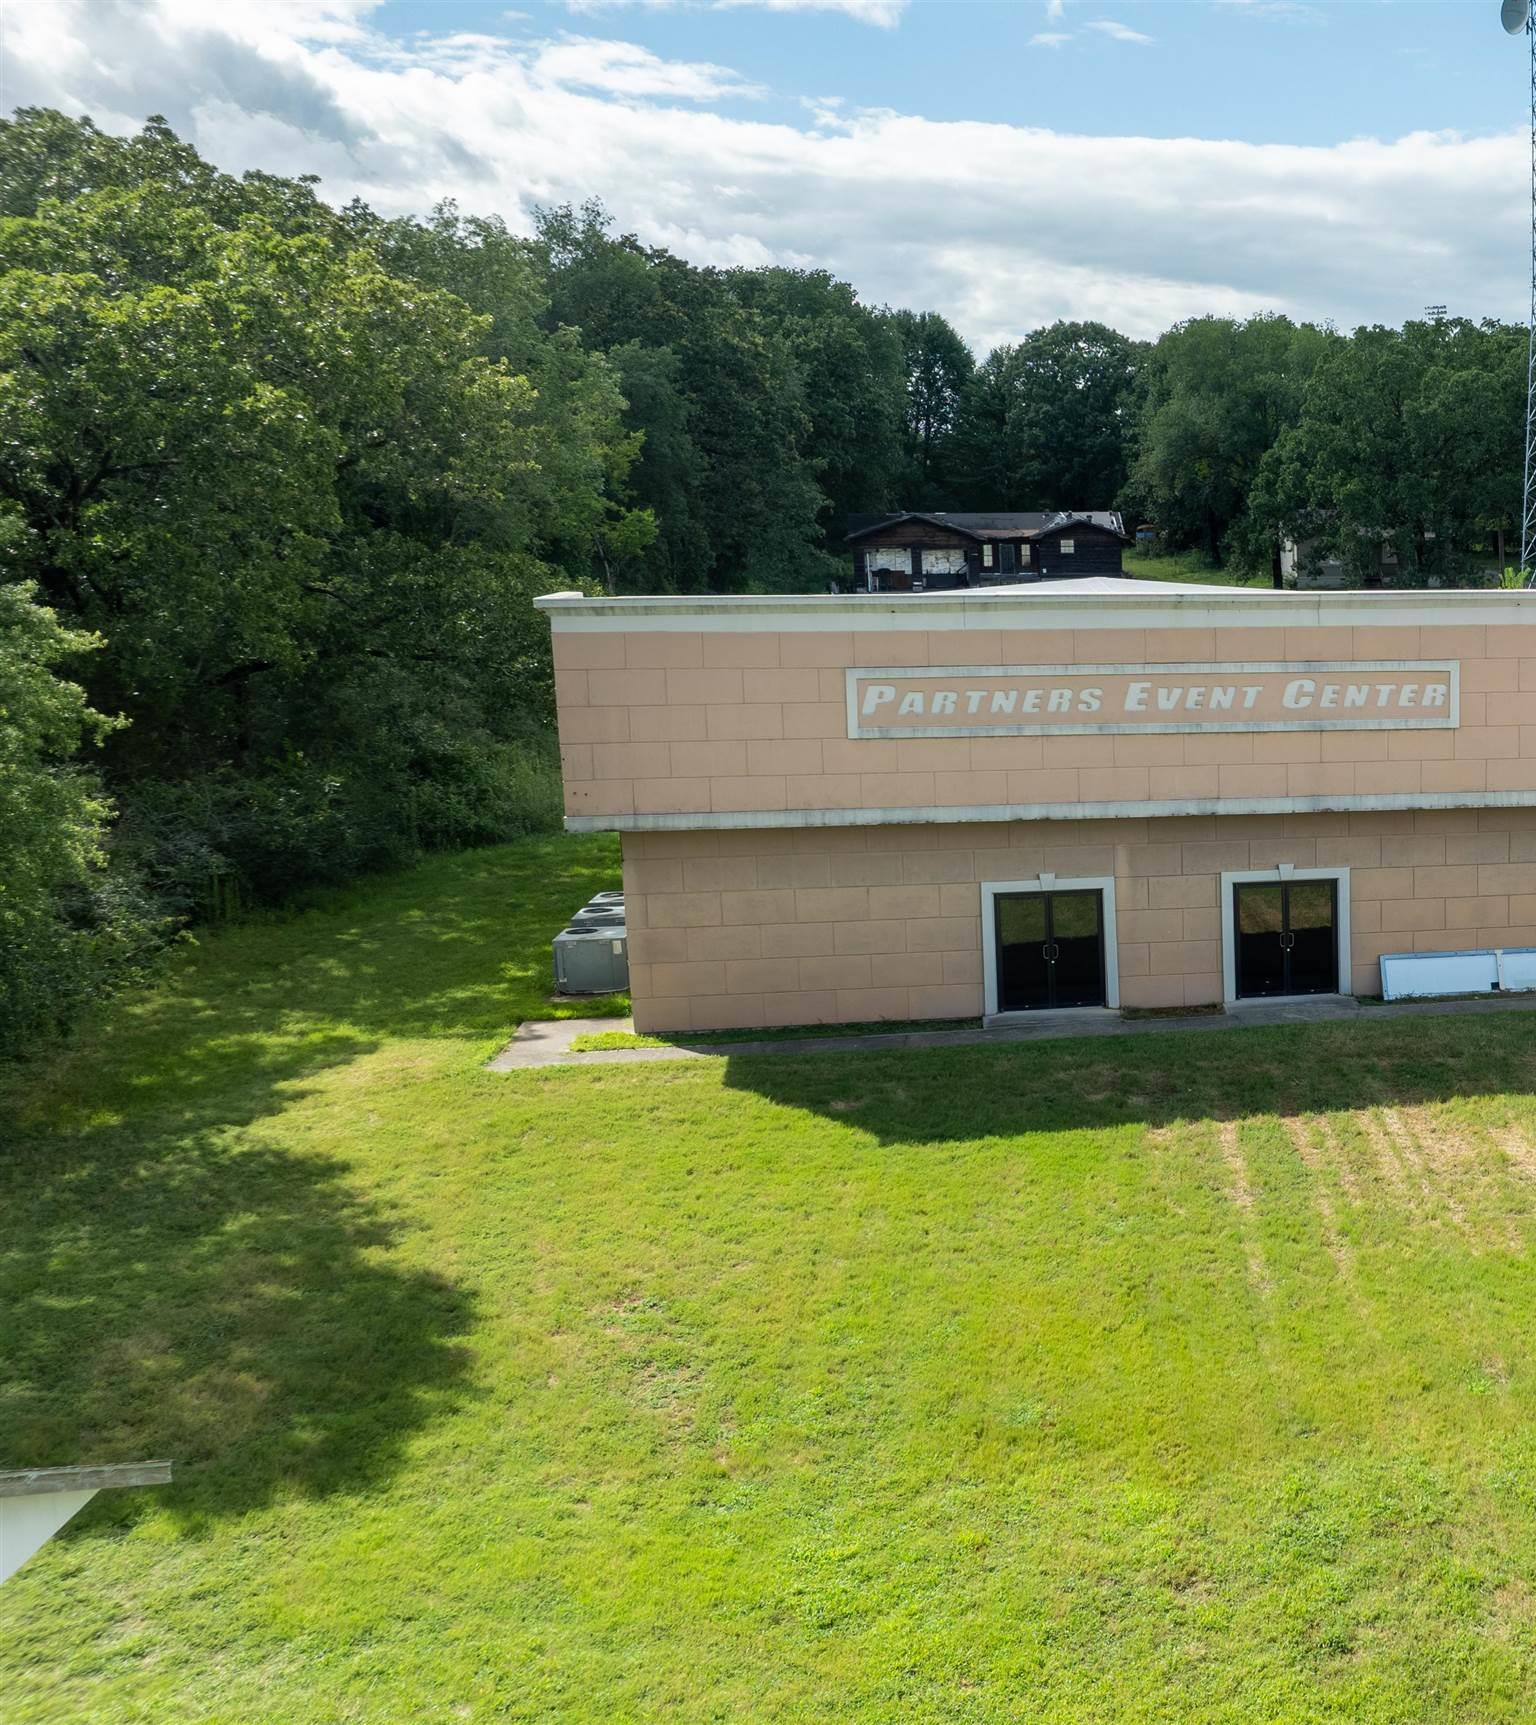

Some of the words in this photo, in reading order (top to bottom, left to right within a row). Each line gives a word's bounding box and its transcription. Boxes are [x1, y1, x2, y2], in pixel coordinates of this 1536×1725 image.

[862, 685, 1103, 716] PARTNERS
[1124, 681, 1264, 712] EVENT
[1282, 679, 1447, 710] CENTER
